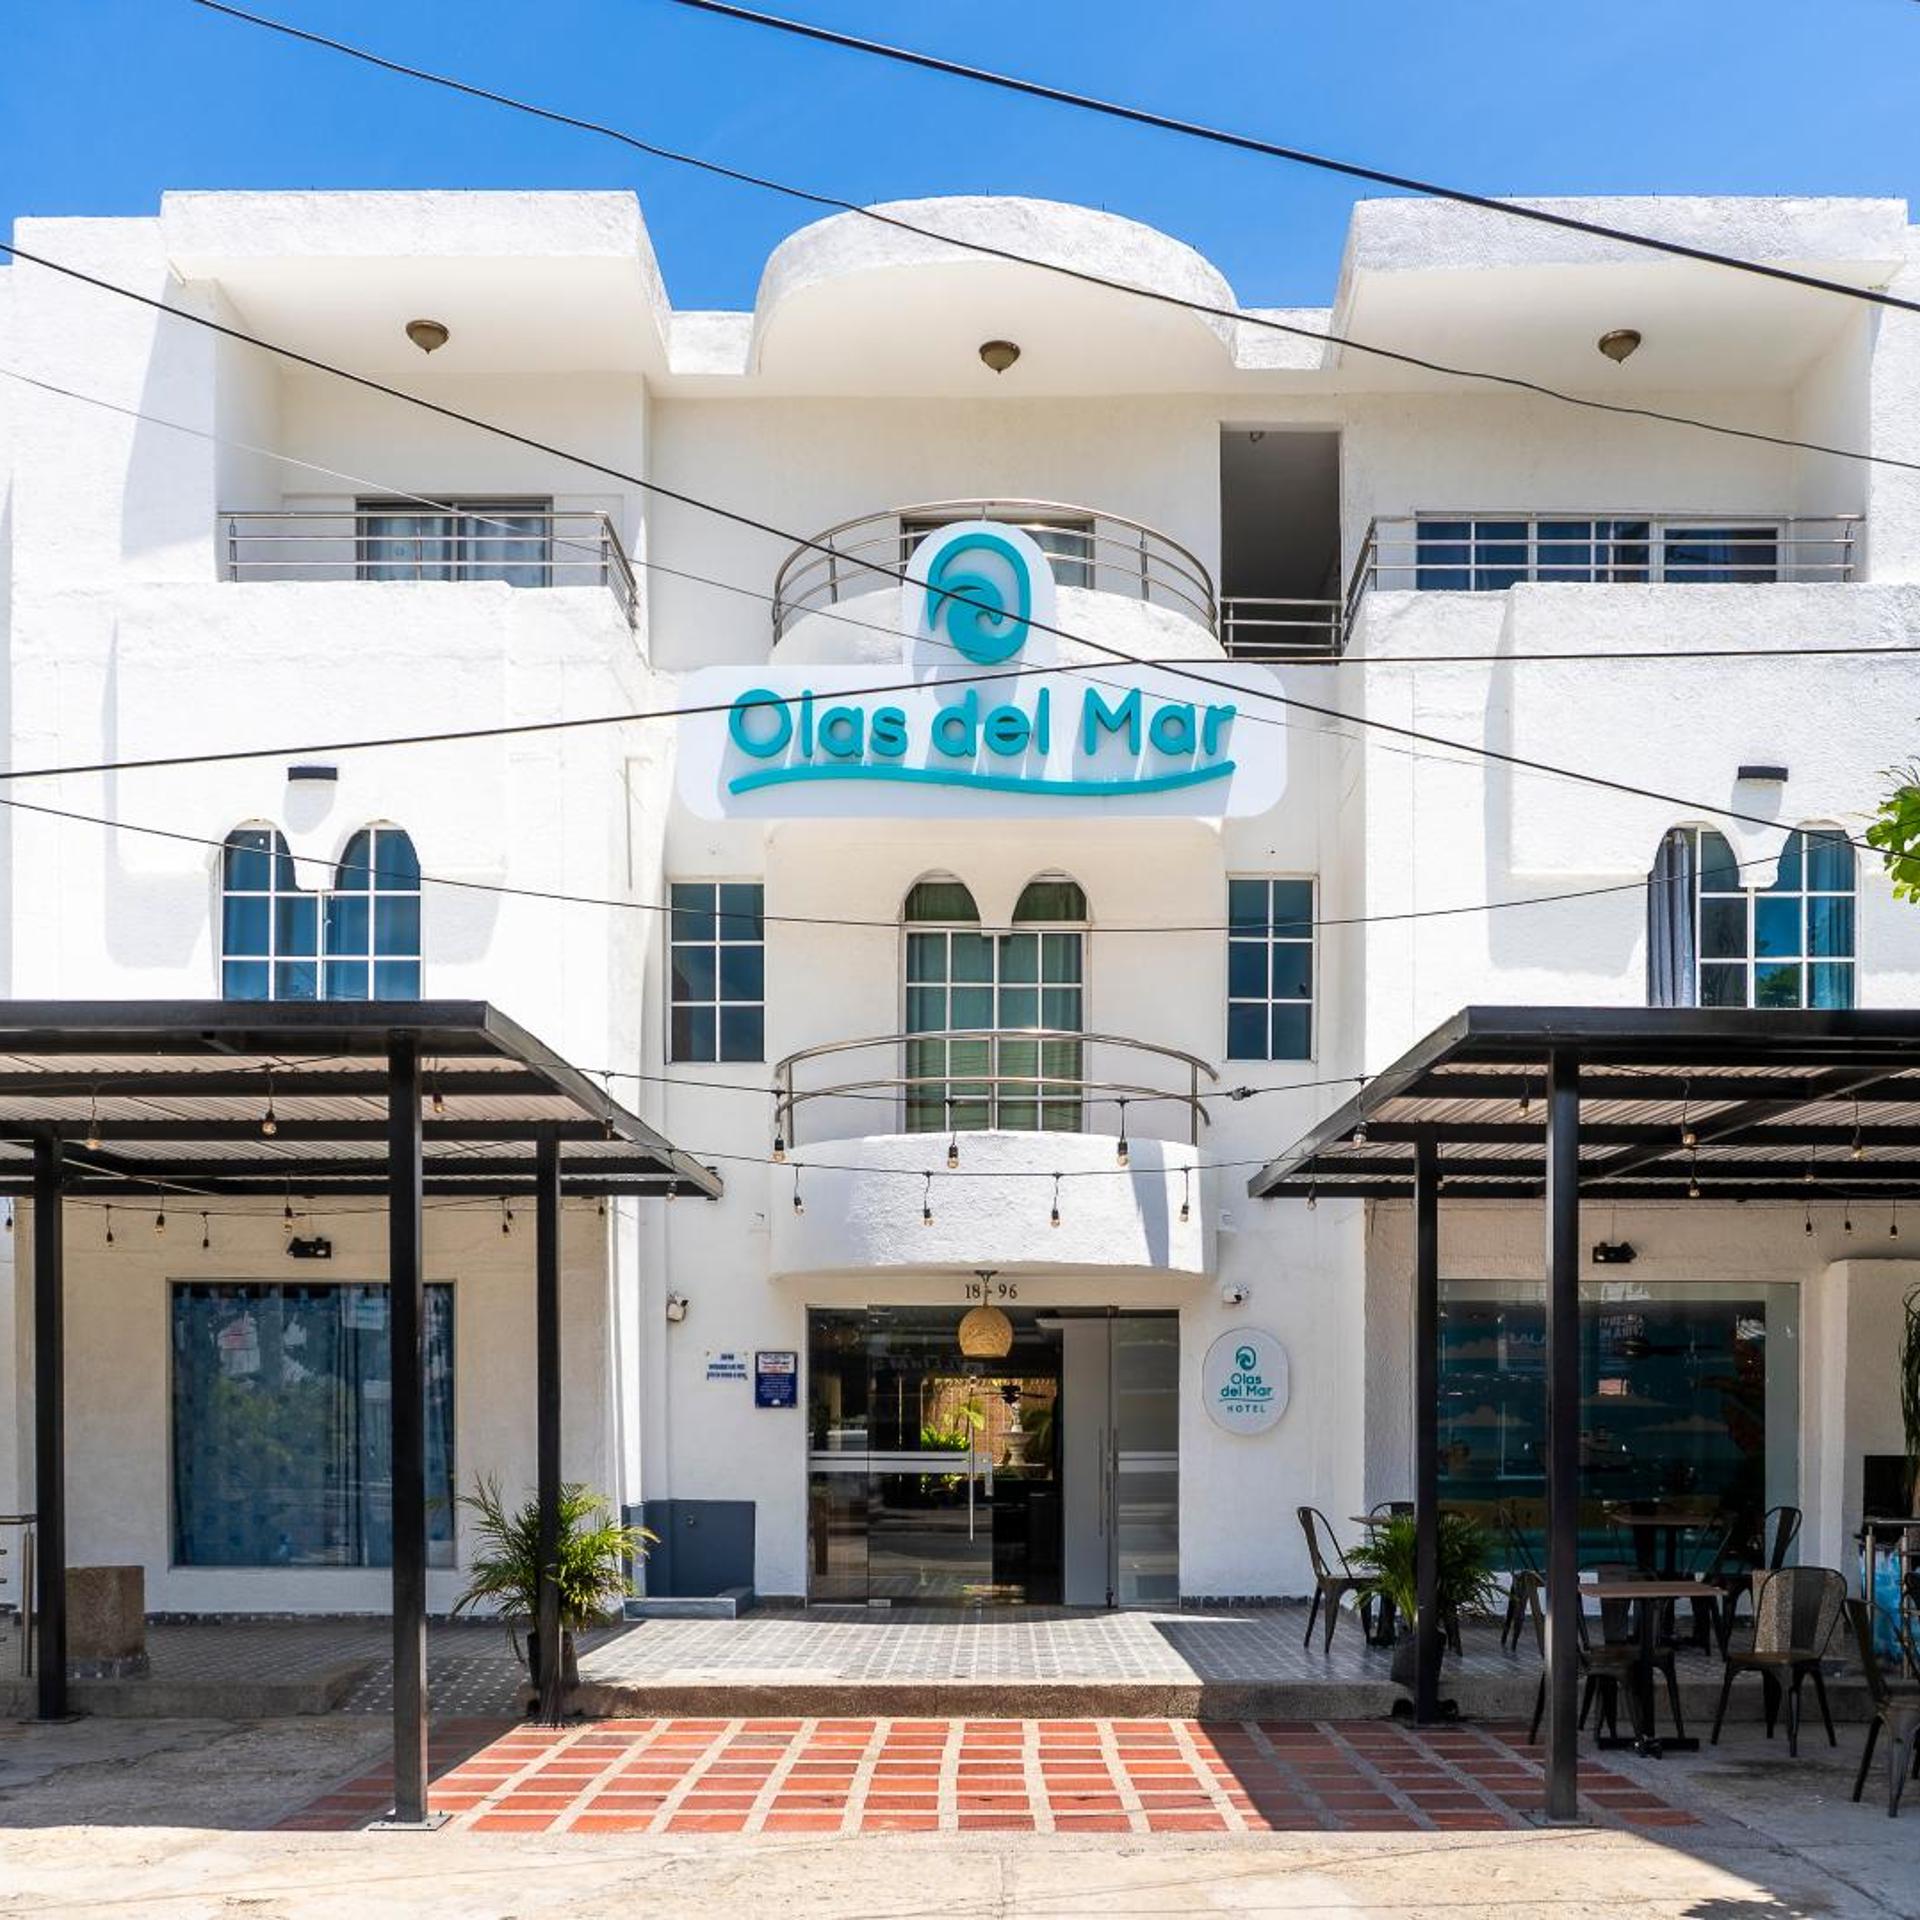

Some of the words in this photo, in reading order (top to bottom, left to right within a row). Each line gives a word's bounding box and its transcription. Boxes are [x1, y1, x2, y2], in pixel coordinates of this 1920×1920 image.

[728, 689, 908, 757] Olas
[931, 688, 1050, 758] del
[1083, 688, 1237, 757] Mar
[1231, 1373, 1262, 1384] Olas
[1220, 1386, 1242, 1397] del
[1246, 1386, 1273, 1397] Mar
[1227, 1404, 1266, 1413] HOTEL
